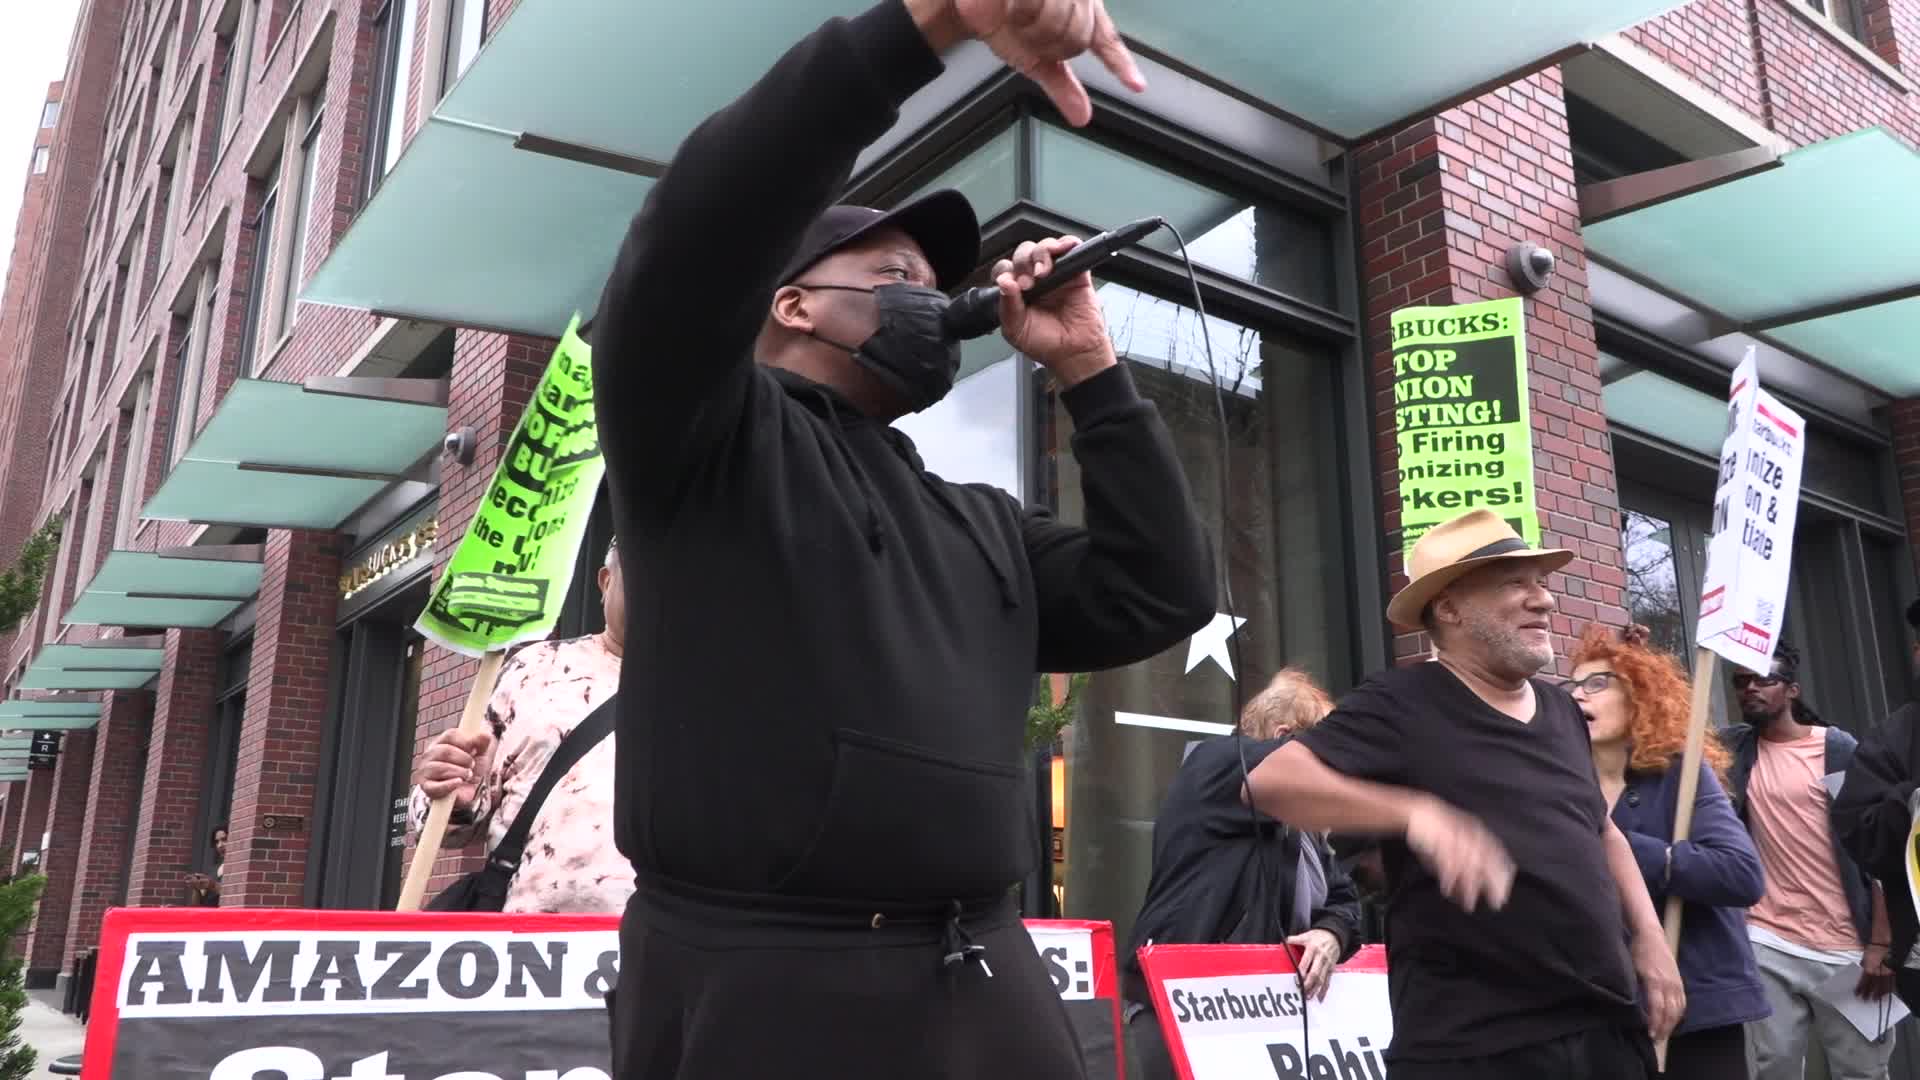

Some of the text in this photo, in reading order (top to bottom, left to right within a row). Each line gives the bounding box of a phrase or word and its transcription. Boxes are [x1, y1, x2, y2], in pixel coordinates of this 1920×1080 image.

[1413, 430, 1505, 455] Firing
[474, 515, 504, 548] the
[41, 744, 49, 752] R
[126, 940, 568, 1006] AMAZON
[1172, 986, 1304, 1023] Starbucks:
[1266, 1036, 1387, 1080] Behi
